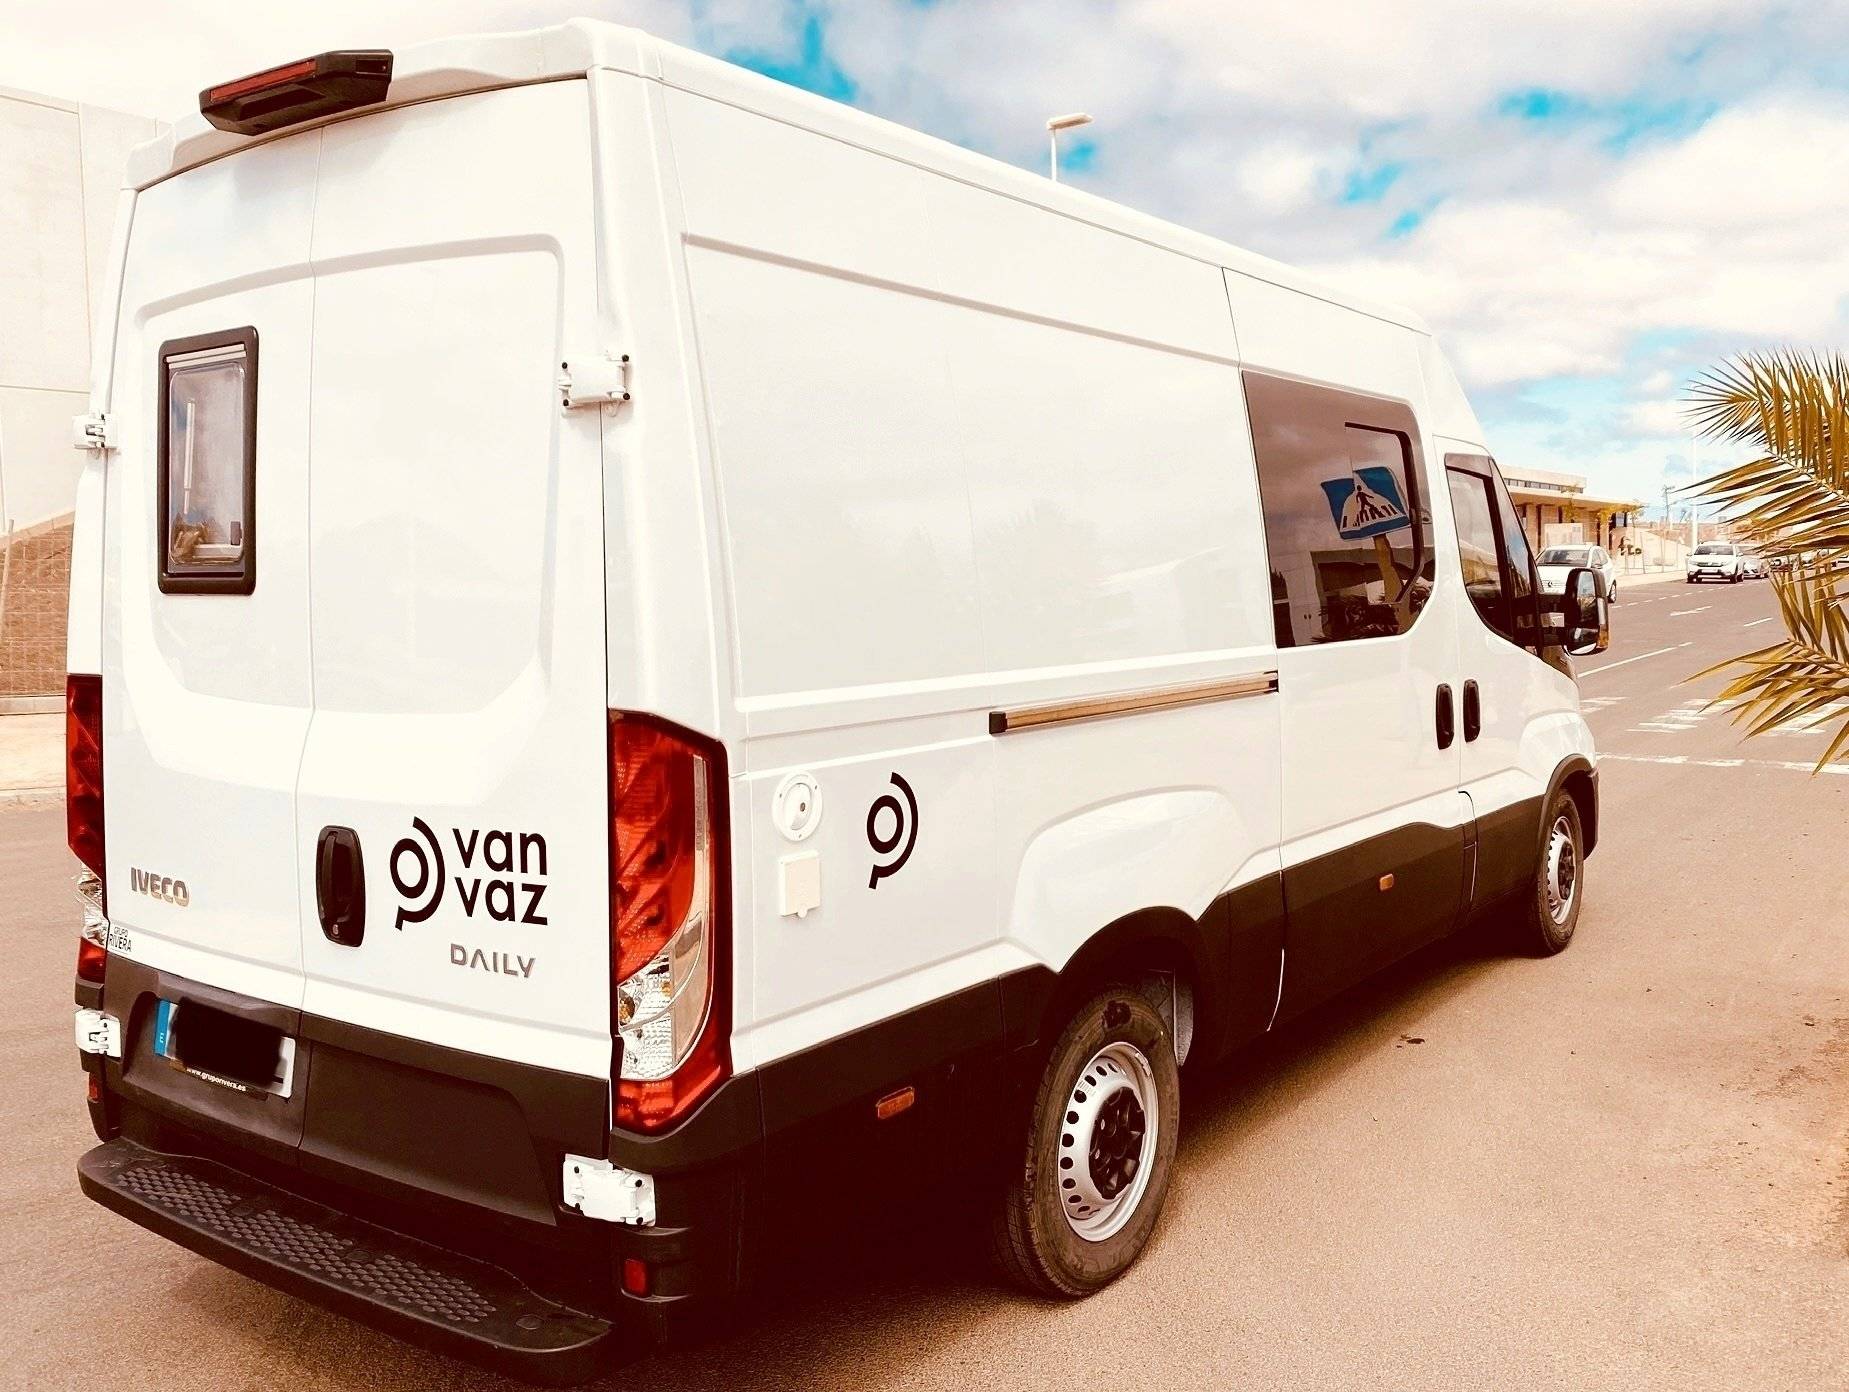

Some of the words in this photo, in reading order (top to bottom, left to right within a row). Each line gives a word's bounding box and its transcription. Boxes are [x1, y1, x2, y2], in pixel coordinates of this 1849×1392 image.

[452, 828, 548, 876] van
[130, 866, 190, 907] IVECO
[454, 876, 549, 926] vaz
[108, 933, 132, 952] RIVERA
[450, 942, 536, 979] DAILY
